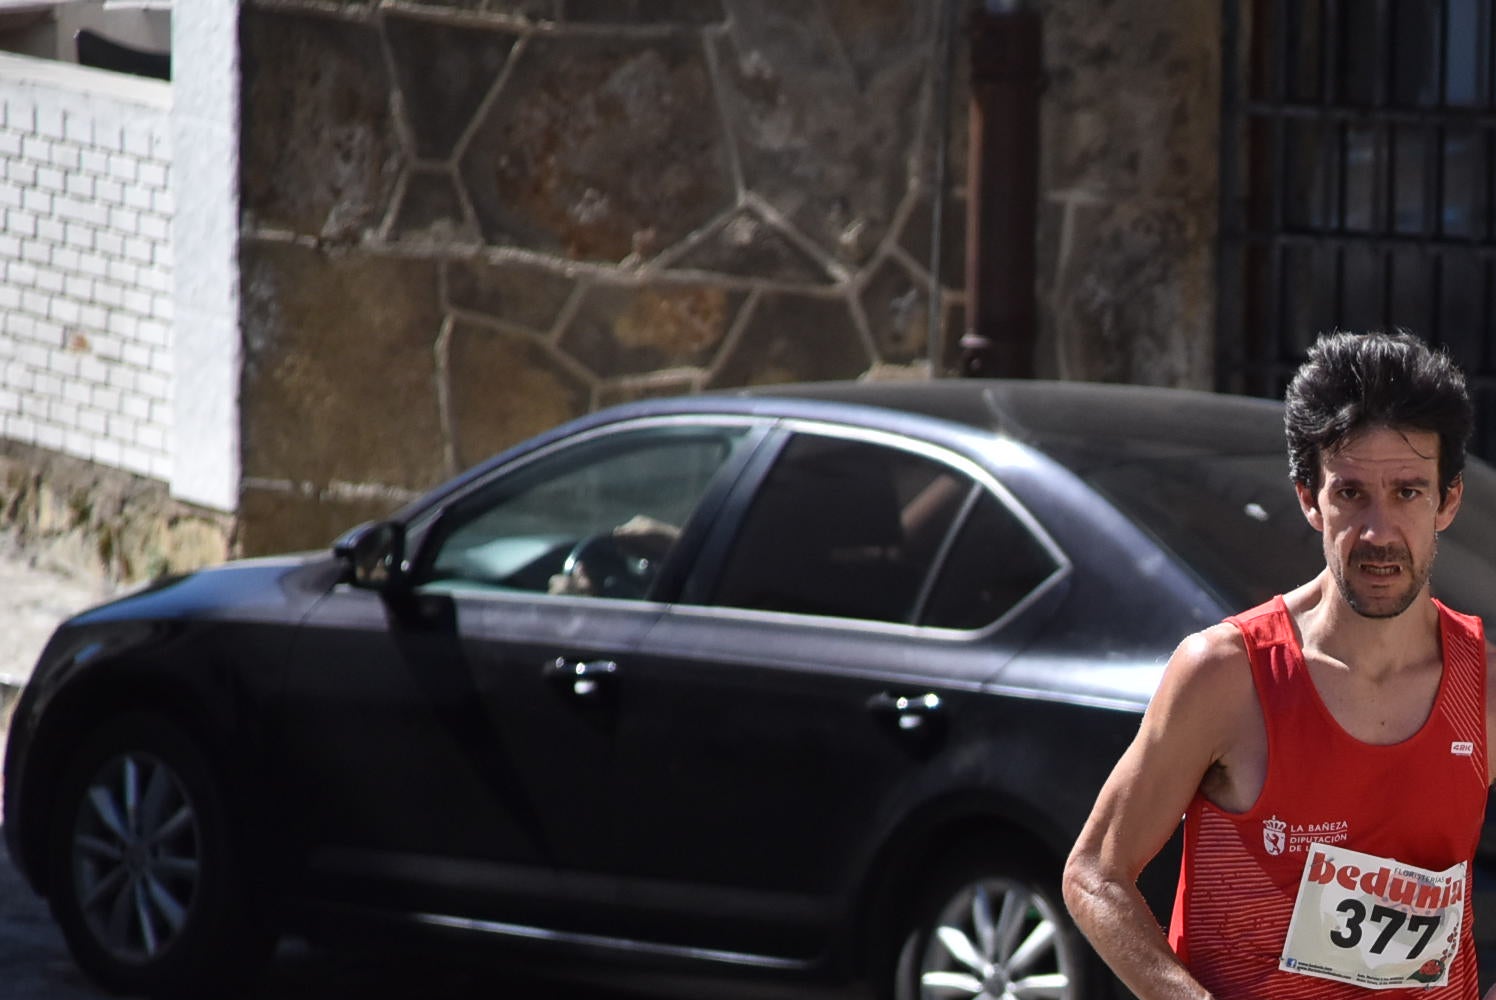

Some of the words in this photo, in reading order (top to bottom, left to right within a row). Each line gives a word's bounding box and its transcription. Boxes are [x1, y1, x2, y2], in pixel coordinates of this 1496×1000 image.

[1289, 833, 1347, 844] DIPUTACIÓN
[1290, 824, 1304, 833] LA
[1308, 820, 1348, 832] BAÑEZA
[1308, 852, 1463, 909] bedunia
[1330, 898, 1441, 960] 377
